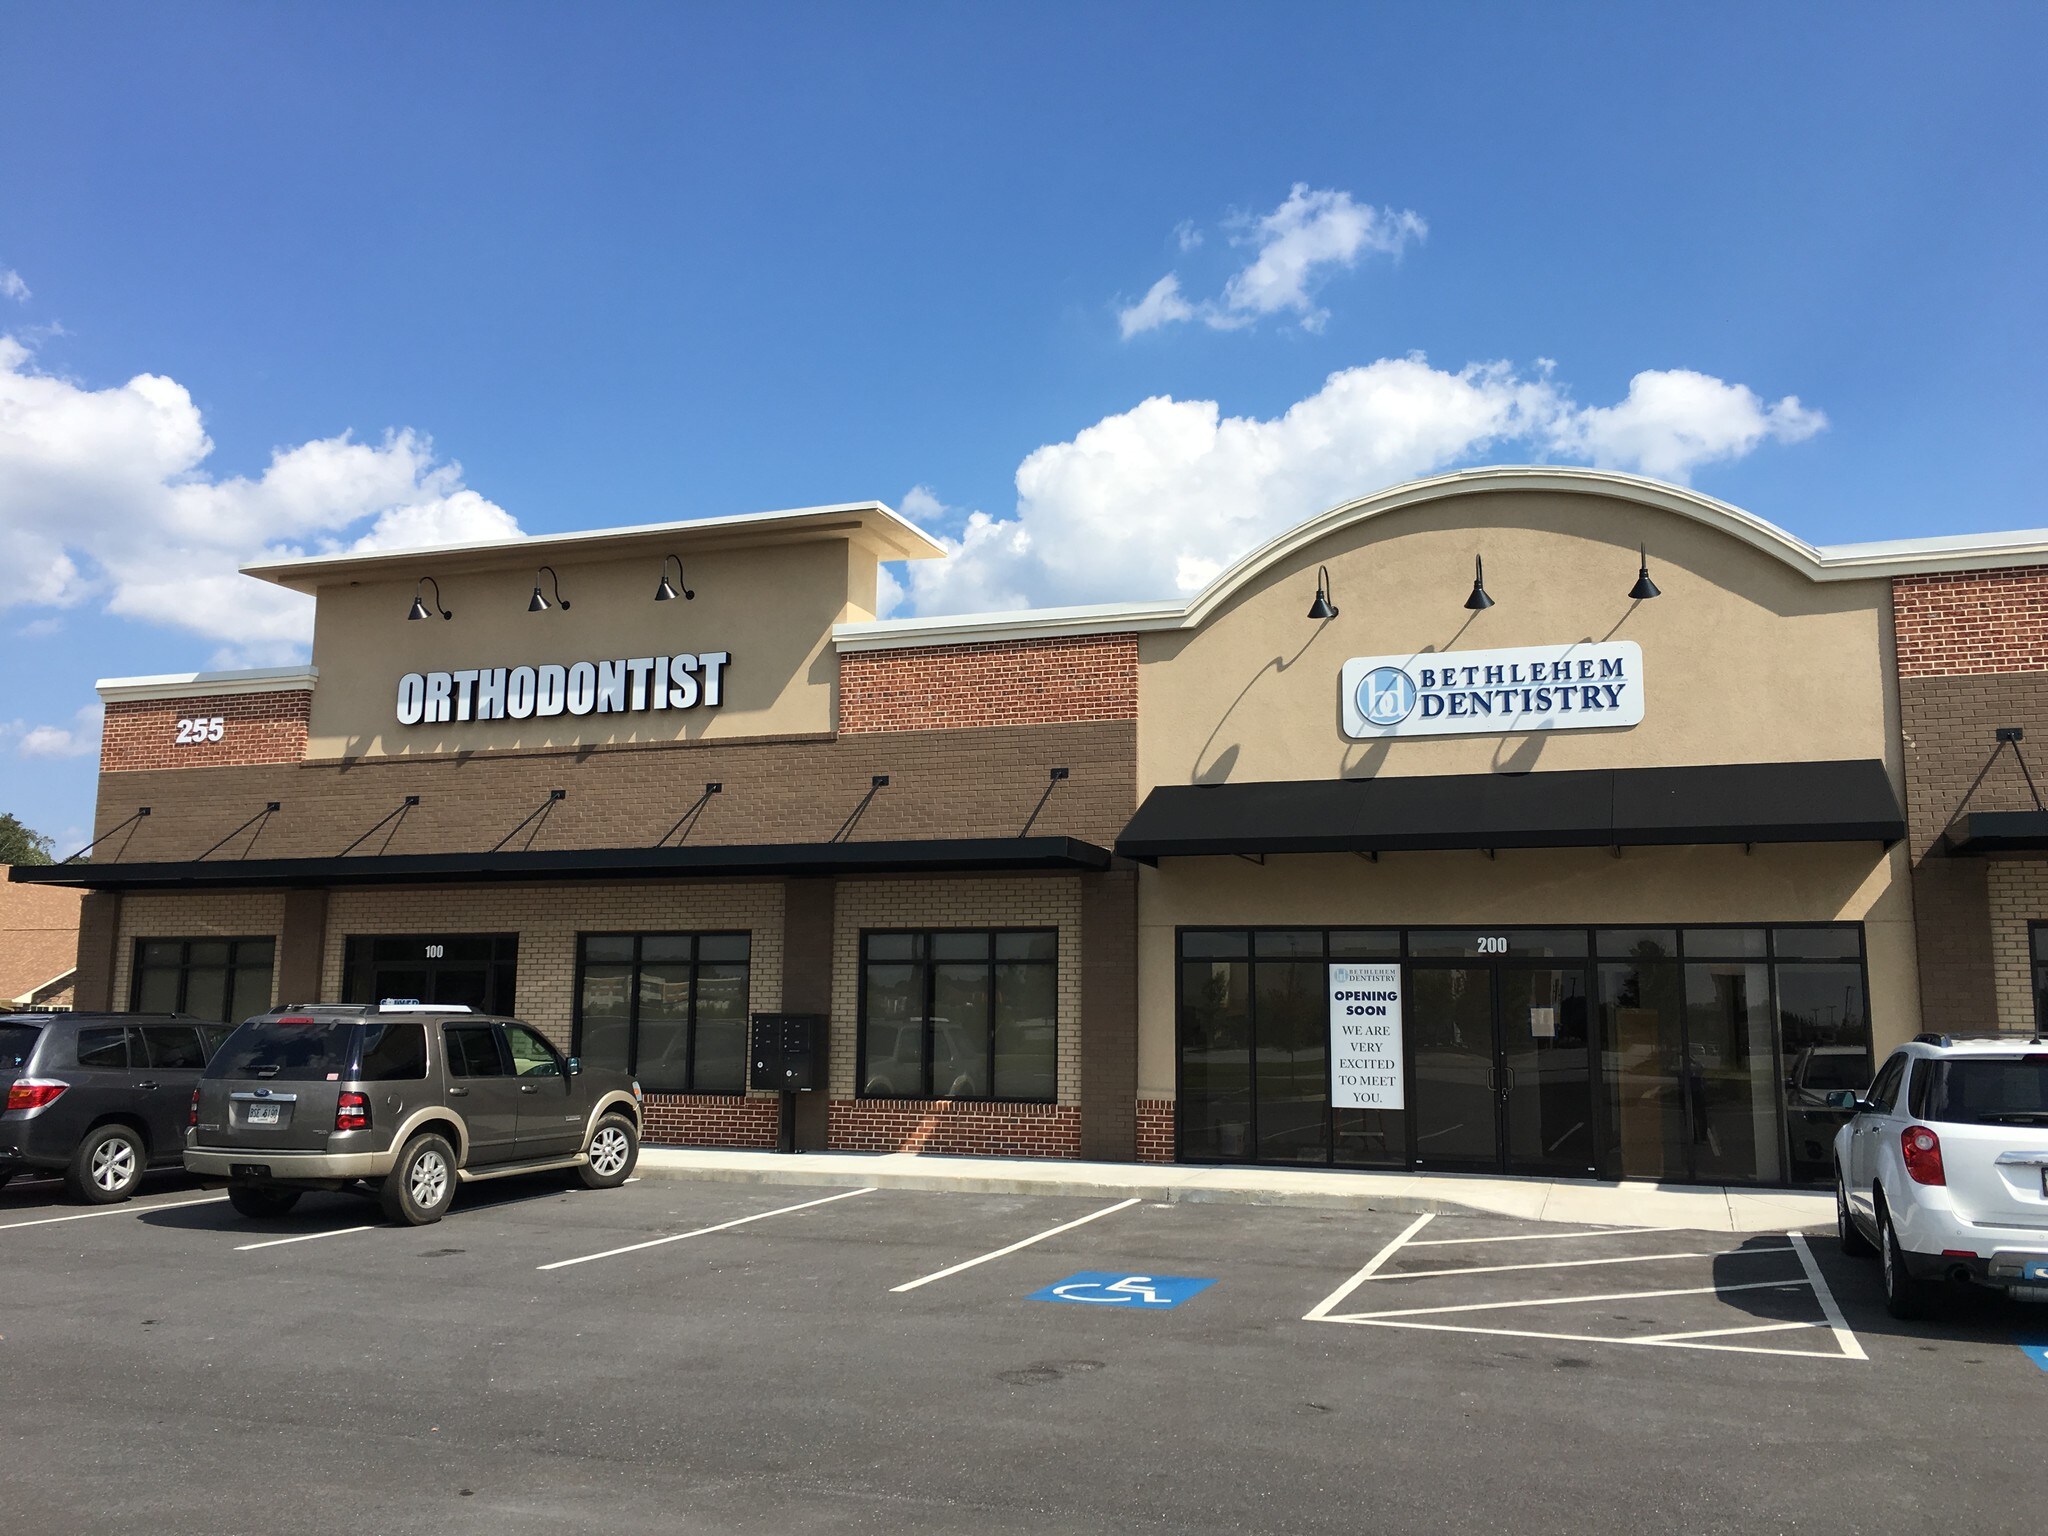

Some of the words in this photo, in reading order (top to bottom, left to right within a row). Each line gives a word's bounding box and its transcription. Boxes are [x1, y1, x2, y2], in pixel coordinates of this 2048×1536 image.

[1421, 658, 1624, 688] BETHLEHEM
[396, 651, 731, 726] ORTHODONTIST
[1421, 683, 1626, 718] DENTISTRY
[175, 716, 224, 743] 255
[1477, 937, 1508, 953] 200
[425, 945, 444, 958] 100
[1334, 991, 1398, 1001] OPENING
[1346, 1005, 1386, 1016] SOON
[1342, 1026, 1363, 1035] WE
[1365, 1026, 1390, 1036] ARE
[1350, 1042, 1383, 1052] VERY
[1339, 1059, 1395, 1069] EXCITED
[1338, 1075, 1357, 1085] TO
[1360, 1076, 1397, 1087] MEET
[1353, 1092, 1383, 1103] YOU.
